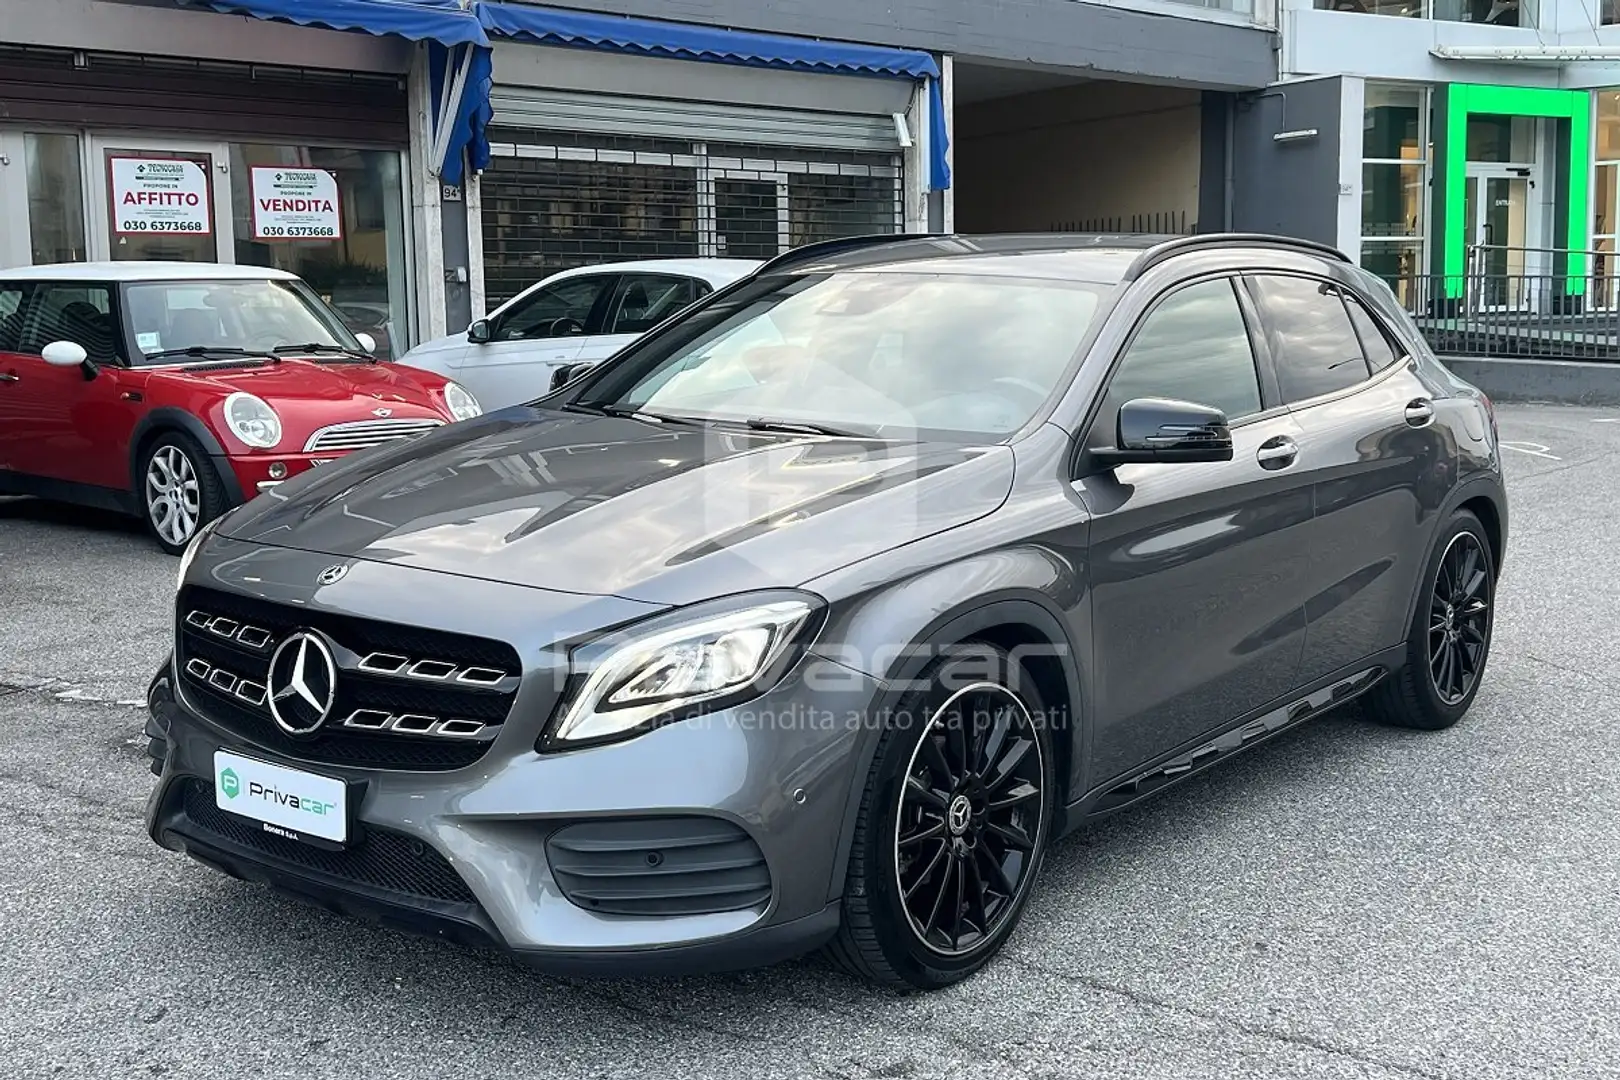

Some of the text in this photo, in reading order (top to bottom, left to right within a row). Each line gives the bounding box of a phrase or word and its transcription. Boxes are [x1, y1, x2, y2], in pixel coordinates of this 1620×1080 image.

[123, 191, 199, 206] AFFITTO
[260, 198, 334, 212] VENDITA
[123, 220, 202, 231] 030 6373668
[263, 226, 334, 236] 030 6373668
[249, 782, 335, 815] Privacar
